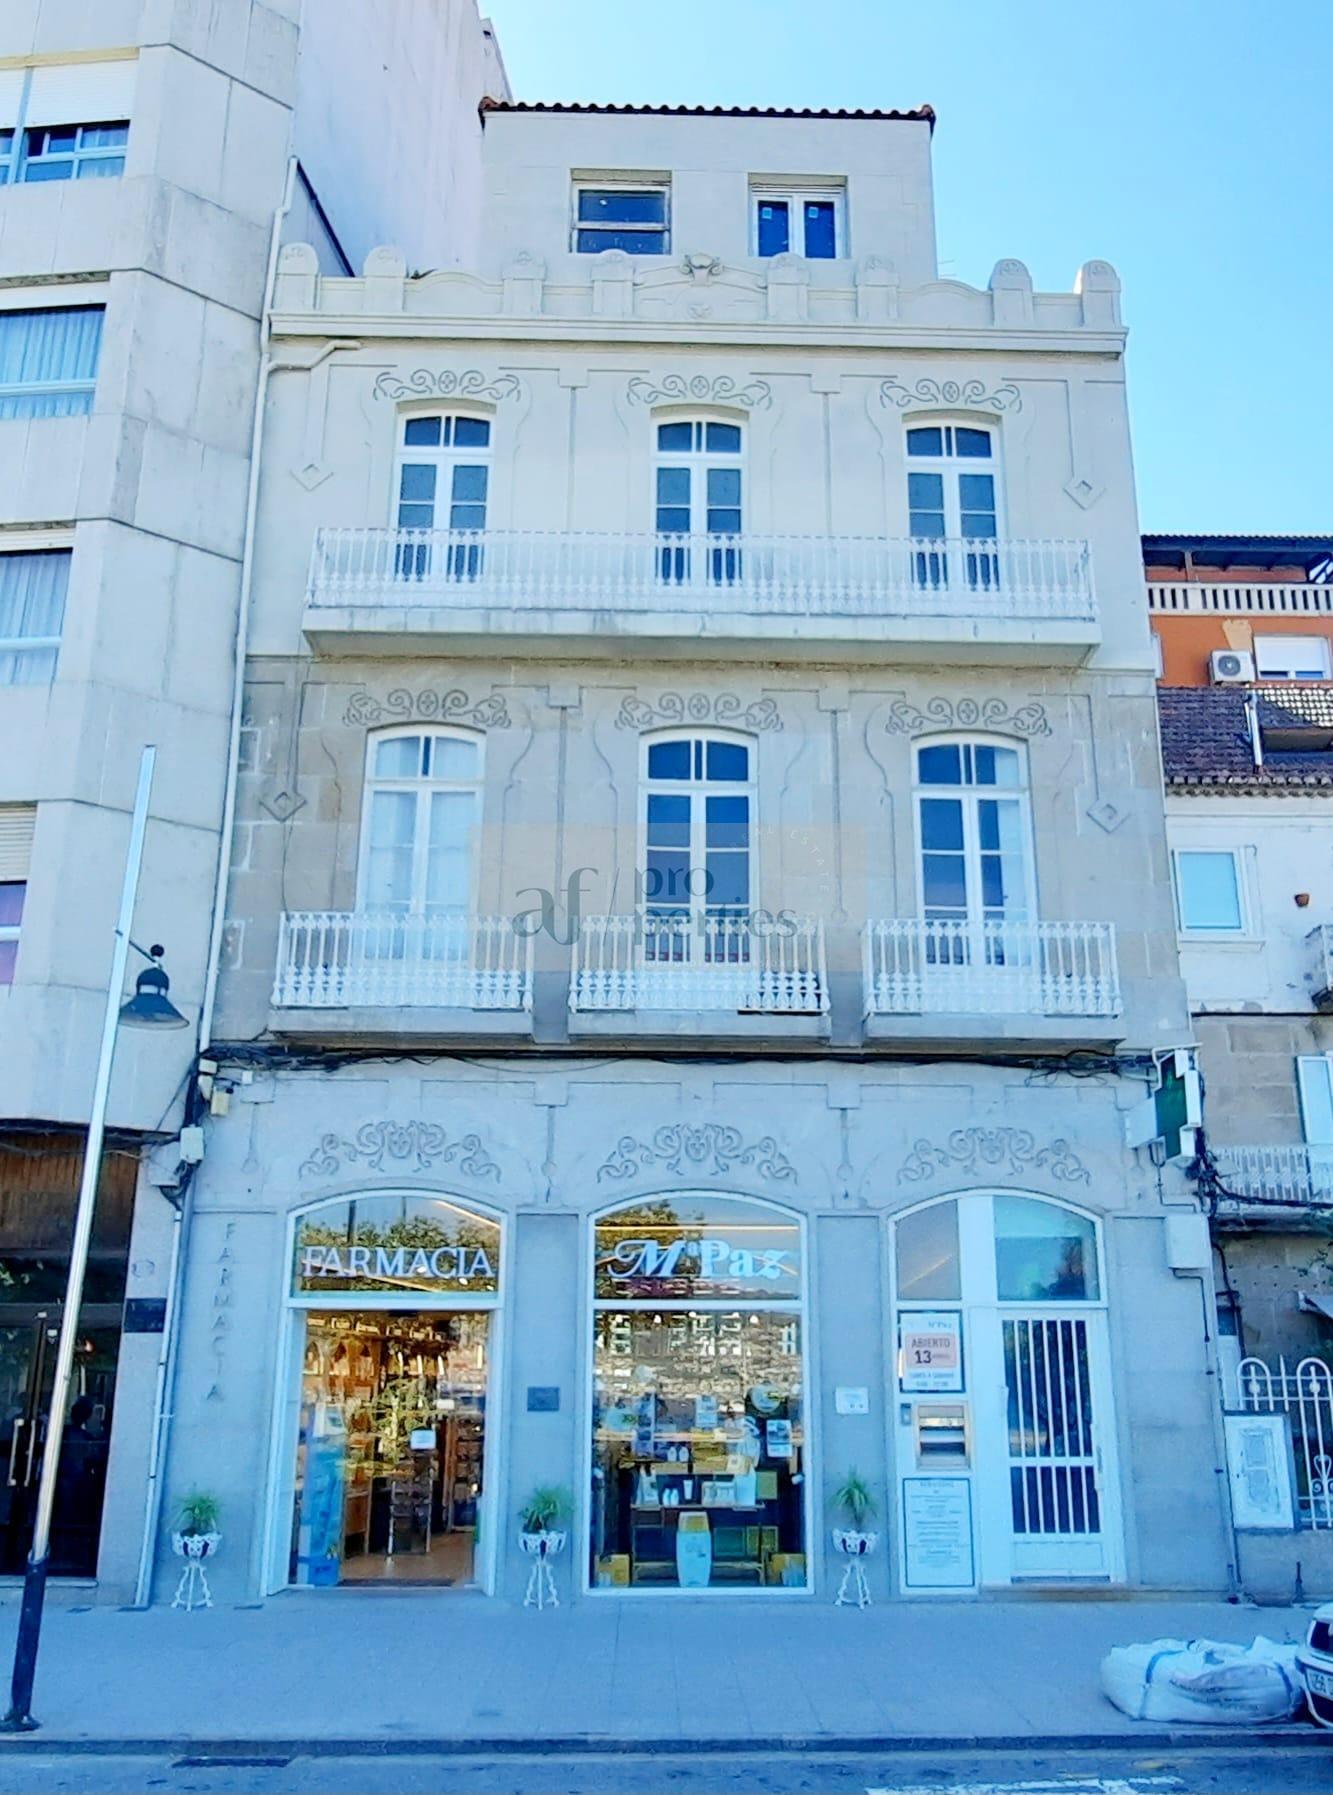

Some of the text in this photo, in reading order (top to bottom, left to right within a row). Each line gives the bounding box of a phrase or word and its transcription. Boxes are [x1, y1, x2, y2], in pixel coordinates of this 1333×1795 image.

[303, 1246, 494, 1278] FARMACIA
[700, 1240, 787, 1279] Paz
[206, 1223, 236, 1401] FARMACIA
[914, 1349, 931, 1364] 13
